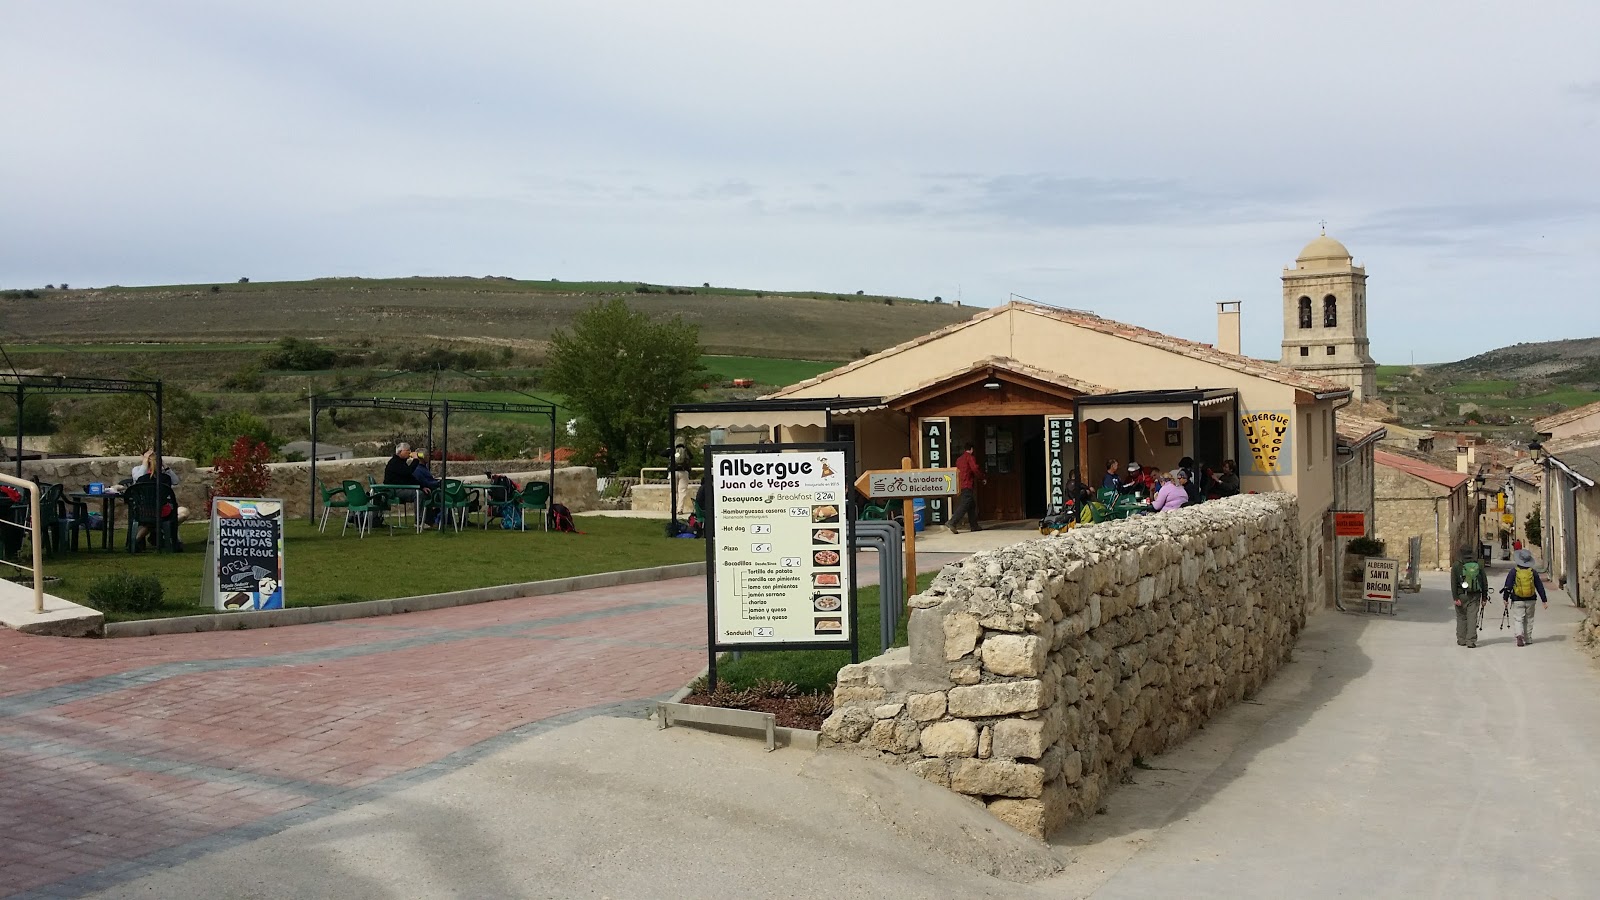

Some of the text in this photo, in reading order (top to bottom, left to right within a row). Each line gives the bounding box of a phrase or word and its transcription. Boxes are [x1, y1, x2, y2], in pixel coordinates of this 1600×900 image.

[1242, 414, 1288, 426] ALBERGUE
[1064, 420, 1073, 442] BAR
[1246, 426, 1262, 460] Juan
[1269, 426, 1286, 466] Yepes
[720, 459, 812, 480] Albergue
[929, 426, 940, 522] ALBUE
[720, 479, 800, 490] Juan de Yepes
[722, 492, 812, 504] Desayunos Breakfast
[220, 519, 272, 528] DESAYUNOS
[221, 529, 272, 538] ALMUERZOS
[221, 538, 272, 548] COMIDAS
[755, 544, 764, 552] 6
[224, 548, 274, 558] ALBERGUE
[222, 558, 248, 576] OPEN
[786, 558, 792, 568] 2
[1368, 562, 1394, 570] ALBERGUE
[1370, 570, 1389, 580] SANTA
[758, 628, 764, 636] 2
